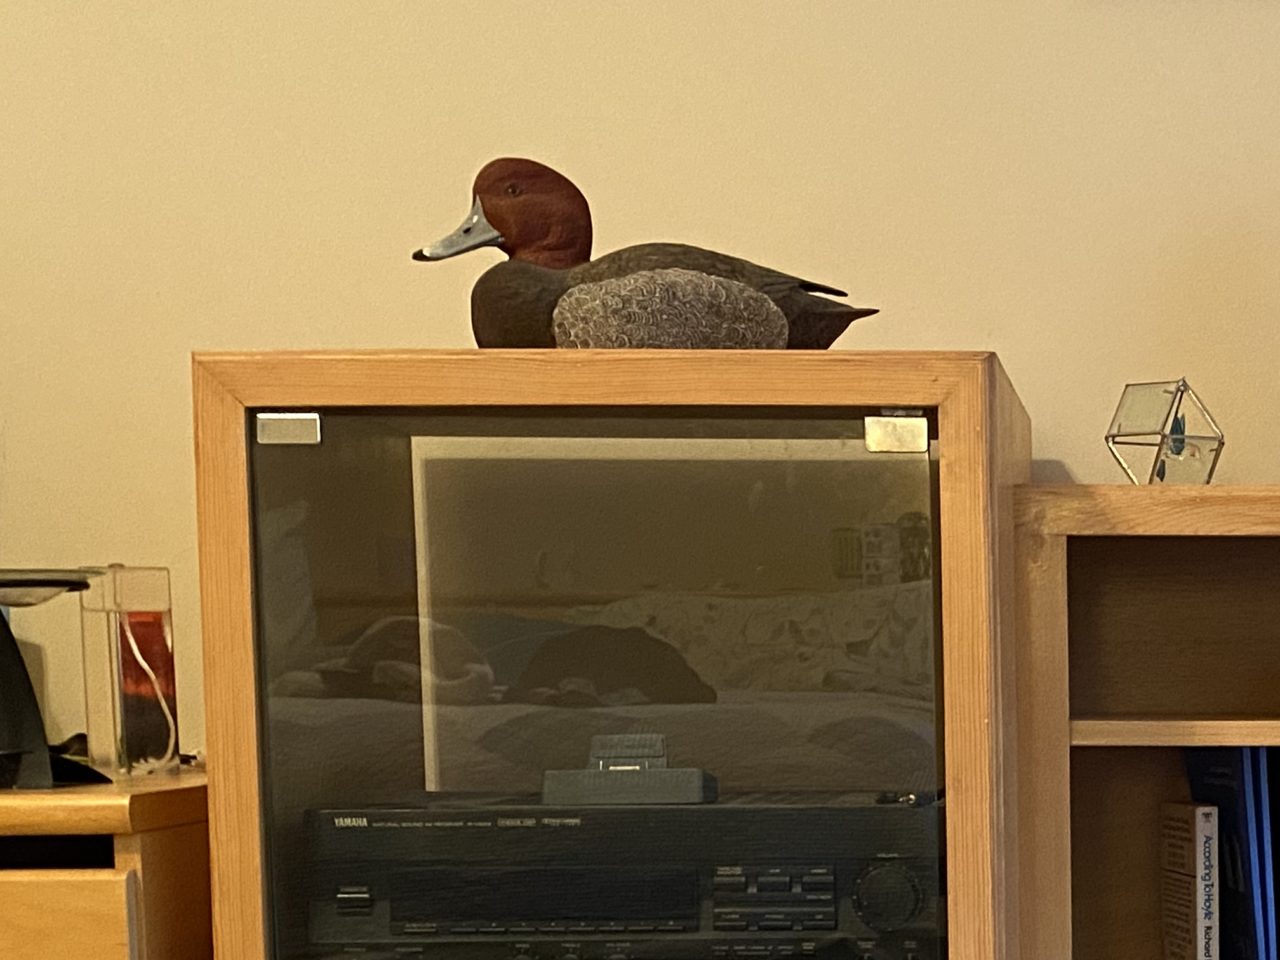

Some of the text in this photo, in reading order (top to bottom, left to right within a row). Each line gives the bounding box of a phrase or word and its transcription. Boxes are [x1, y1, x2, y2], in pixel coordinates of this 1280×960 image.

[334, 817, 368, 827] YAMAHA
[1201, 835, 1215, 920] According To Hoyle
[1203, 925, 1213, 957] Richard
